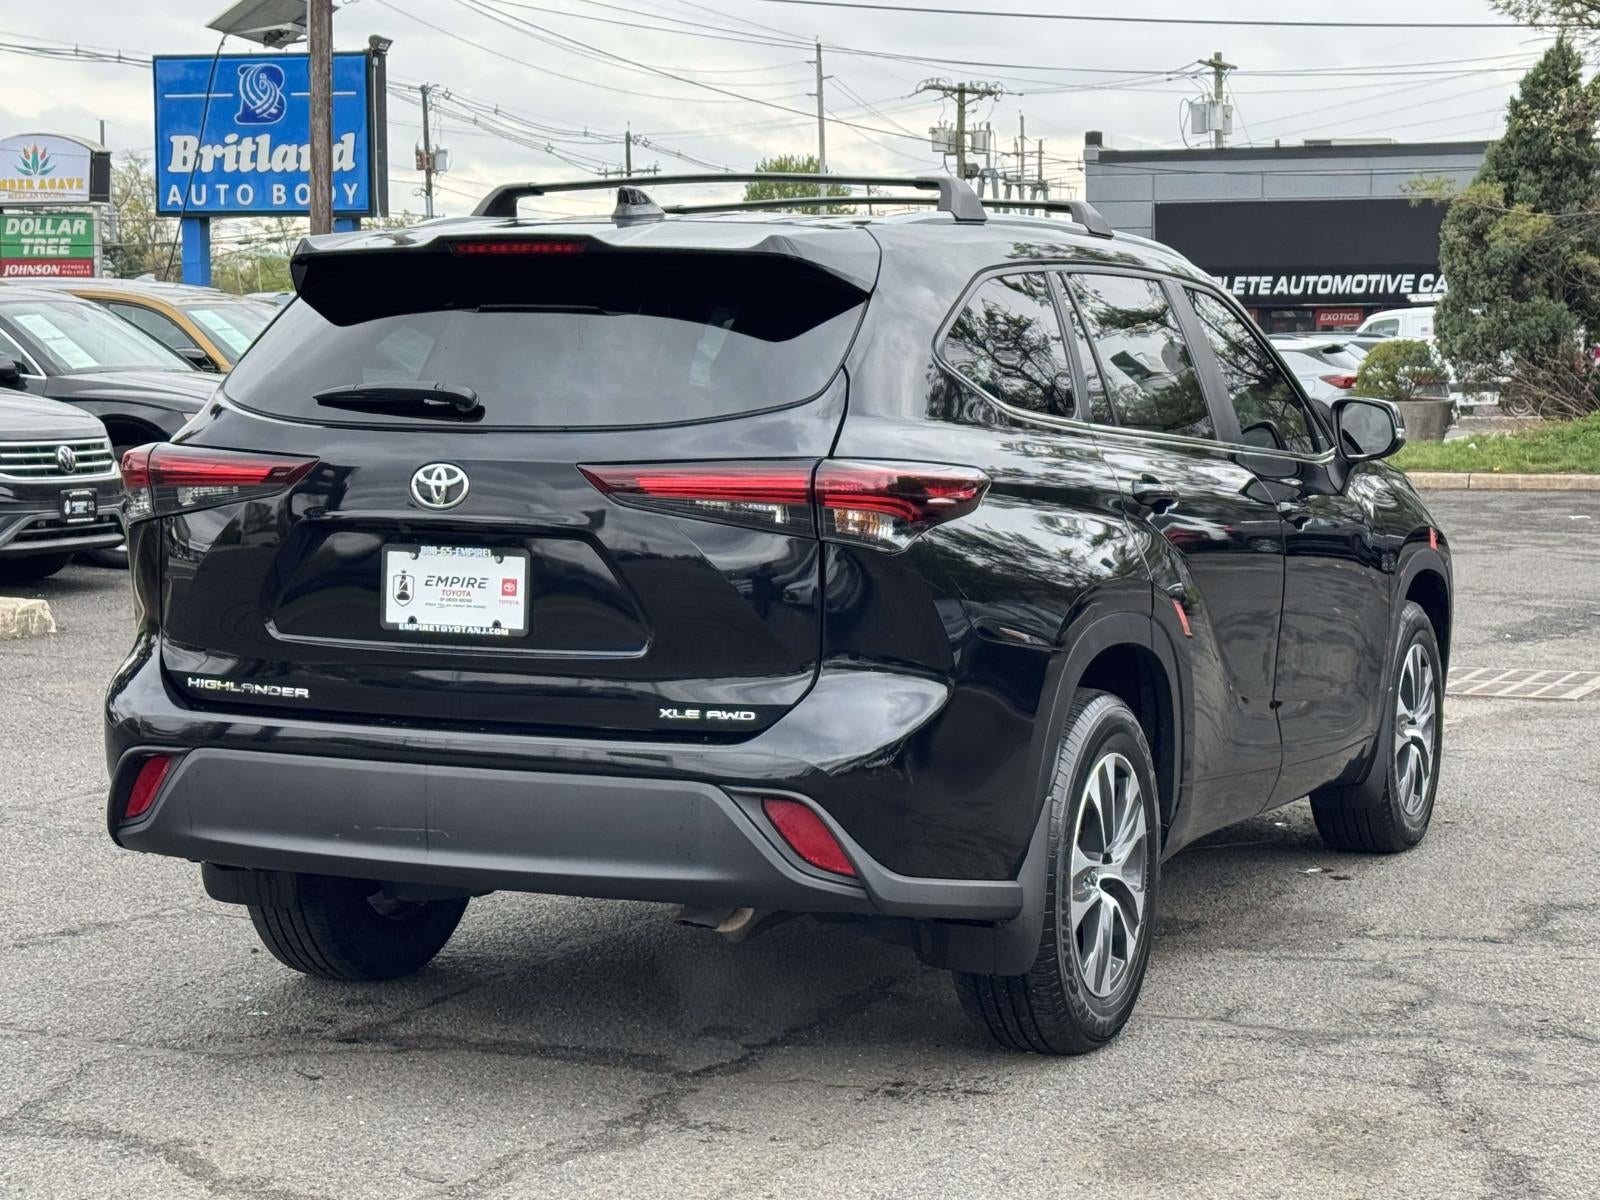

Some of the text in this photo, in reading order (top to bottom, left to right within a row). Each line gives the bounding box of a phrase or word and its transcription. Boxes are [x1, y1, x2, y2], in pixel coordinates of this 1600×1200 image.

[39, 177, 84, 190] AGAVE
[166, 182, 359, 206] AUTO BOY
[5, 218, 87, 235] DOLLAR
[20, 238, 72, 255] TREE
[3, 264, 60, 276] JOHNSON
[1272, 274, 1416, 295] AUTOMOTIVE
[1320, 312, 1360, 321] EXOTICS
[424, 575, 489, 589] EMPIRE
[441, 589, 472, 598] TOYOTA
[399, 623, 510, 636] EMPIRETOYOTANJ.COM
[187, 677, 310, 699] HIGHLANDER
[659, 708, 756, 721] XLE AWD
